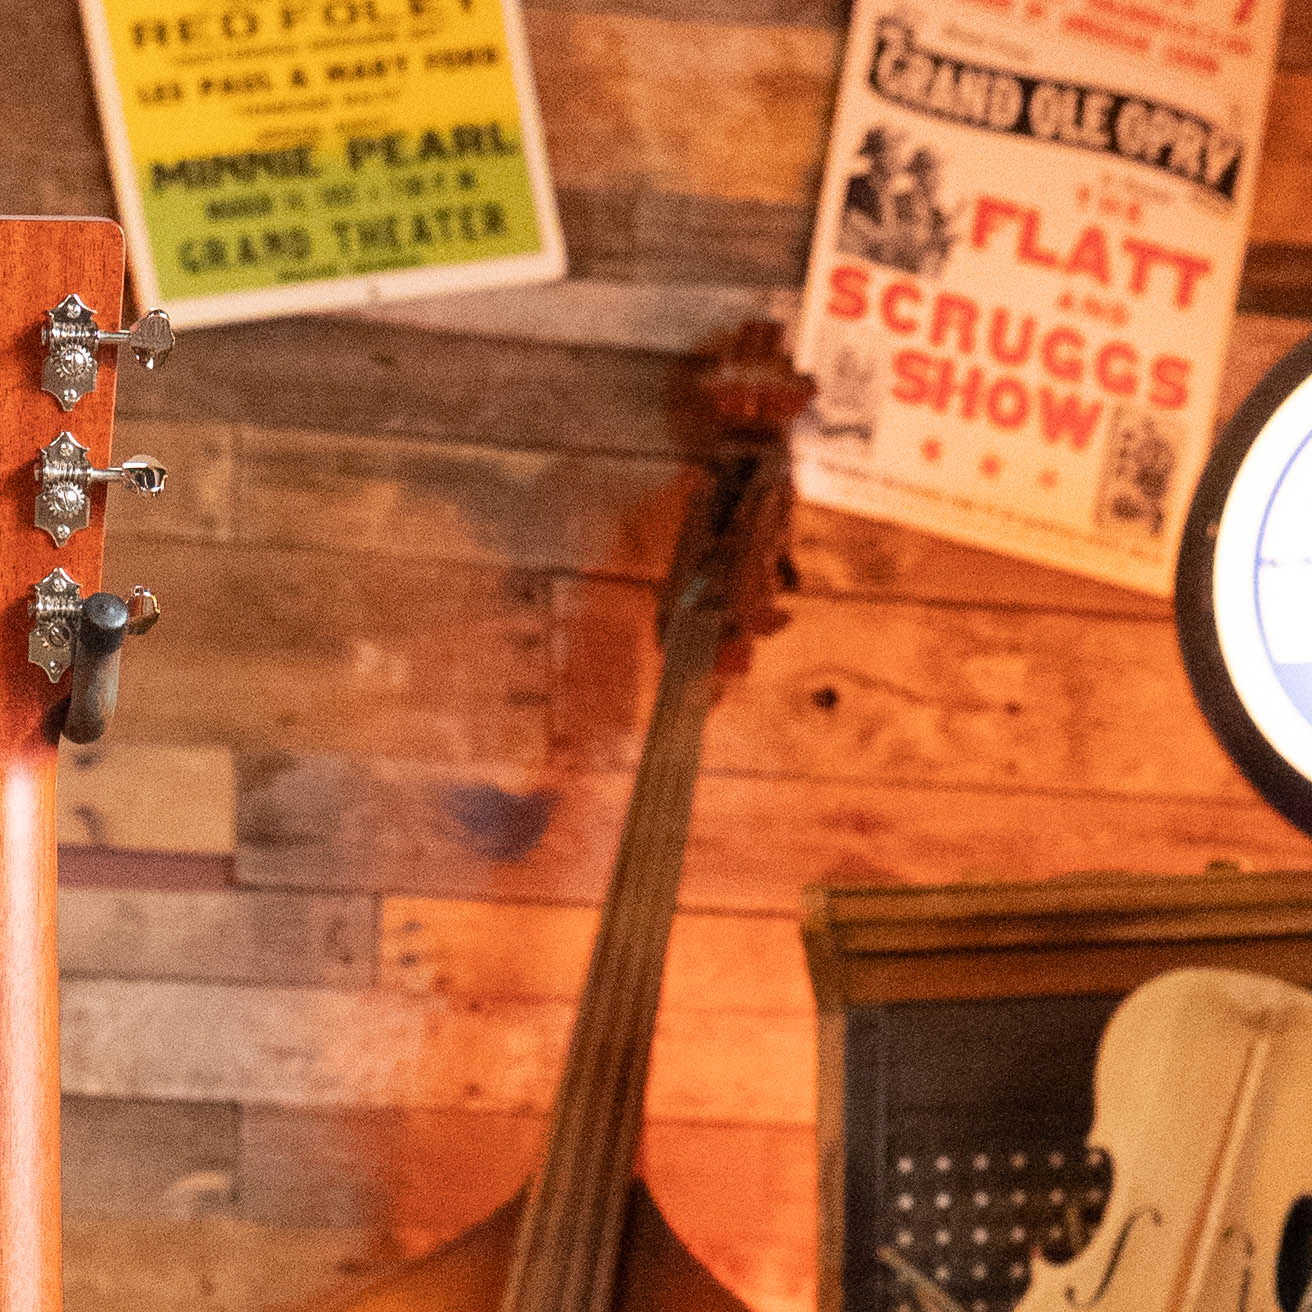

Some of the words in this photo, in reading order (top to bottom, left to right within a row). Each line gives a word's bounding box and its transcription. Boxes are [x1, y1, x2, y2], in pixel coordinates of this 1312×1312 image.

[131, 11, 261, 49] RED
[151, 146, 322, 194] MINNIE
[347, 120, 517, 172] PEARL
[874, 25, 1025, 133] GRAND
[1028, 80, 1116, 150] OLE
[1114, 98, 1244, 192] OPRY
[177, 226, 313, 276] GRAND
[331, 200, 509, 257] THEATER
[971, 195, 1212, 310] FLATT
[827, 265, 1193, 410] SCRUGGS
[893, 350, 1103, 451] SHOW
